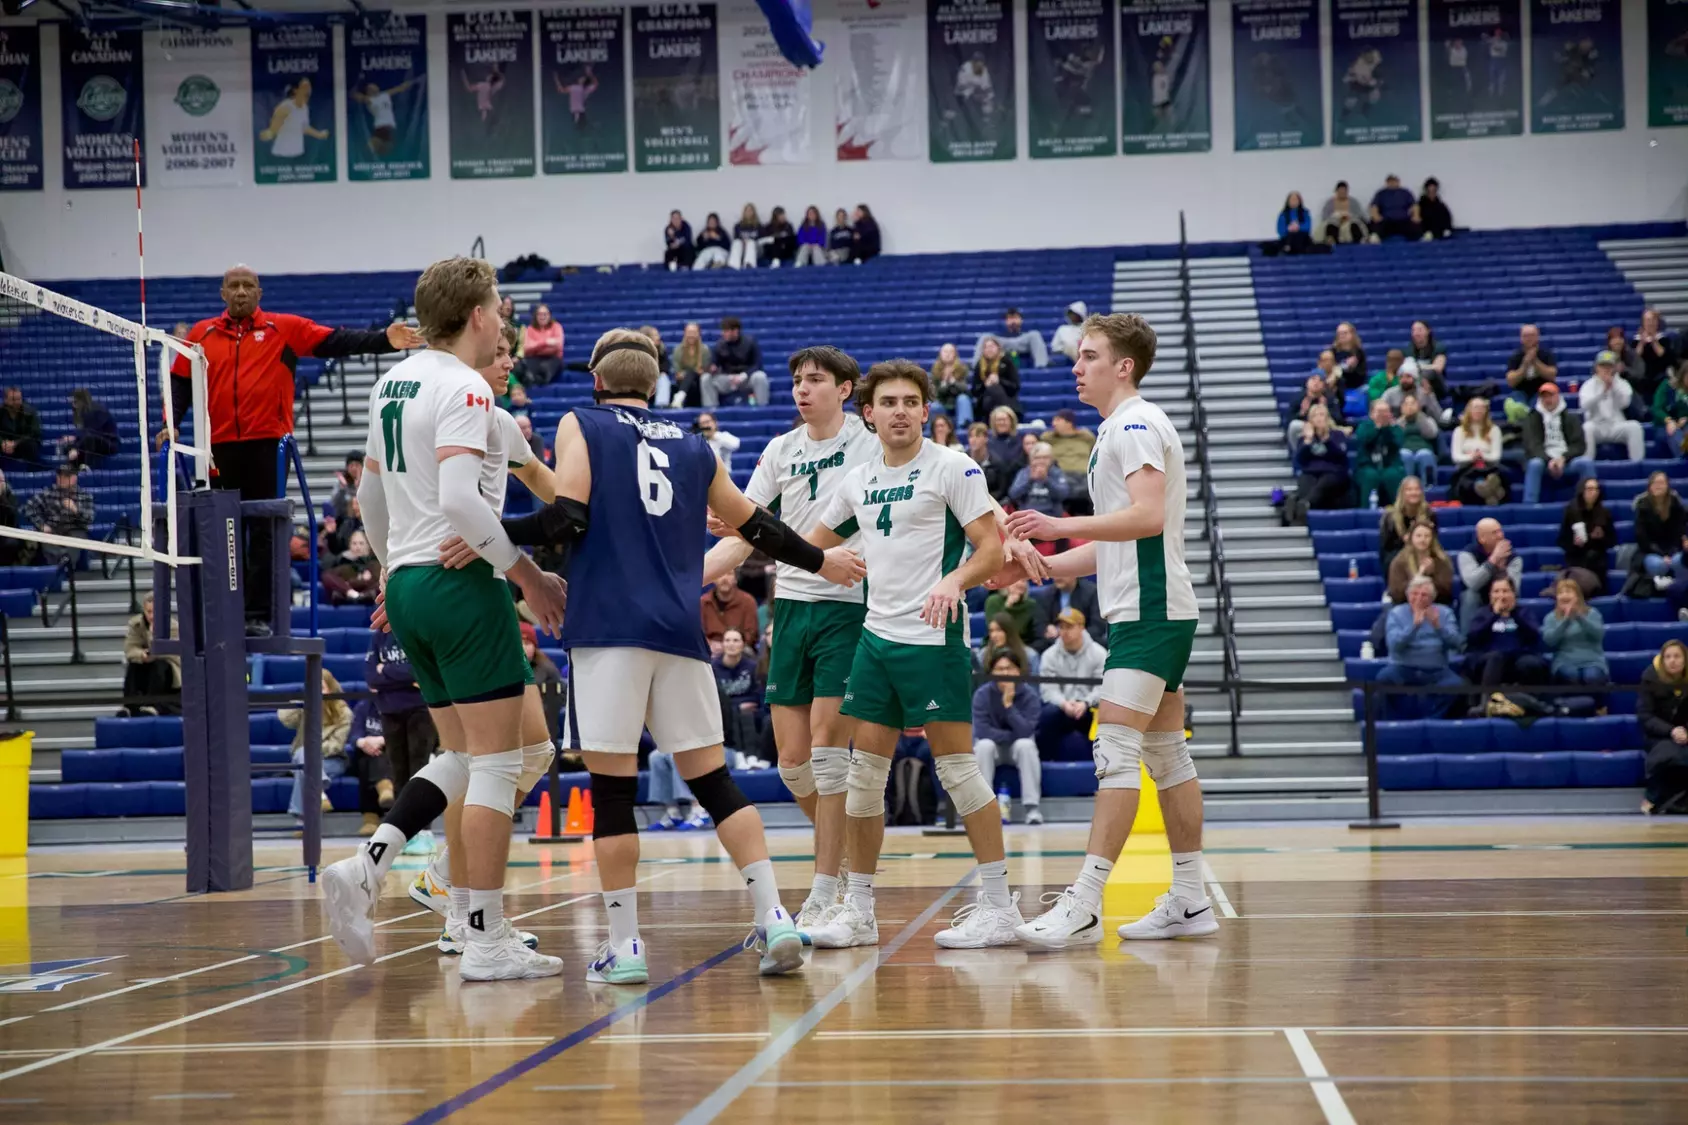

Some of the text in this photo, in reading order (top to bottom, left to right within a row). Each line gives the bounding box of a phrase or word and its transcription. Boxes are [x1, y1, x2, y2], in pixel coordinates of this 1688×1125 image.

[637, 17, 712, 32] CHAMPIONS
[1044, 24, 1098, 40] LAKERS
[1138, 20, 1192, 36] LAKERS
[944, 29, 998, 44] LAKERS
[71, 51, 133, 64] CANADIAN
[465, 48, 517, 63] LAKERS
[557, 48, 609, 63] LAKERS
[649, 43, 701, 59] LAKERS
[268, 57, 319, 74] LAKERS
[361, 55, 412, 71] LAKERS
[75, 133, 133, 146] WOMEN'S
[171, 132, 228, 144] WOMEN'S
[65, 145, 142, 160] VOLLEYBAL
[161, 143, 238, 155] VOLLEYBALL
[165, 158, 236, 170] 2006-2007
[379, 380, 421, 399] LAKERS
[380, 400, 407, 473] 11
[637, 438, 674, 517] 6
[808, 472, 818, 501] 1
[863, 484, 914, 506] LAKERS
[876, 504, 892, 537] 4
